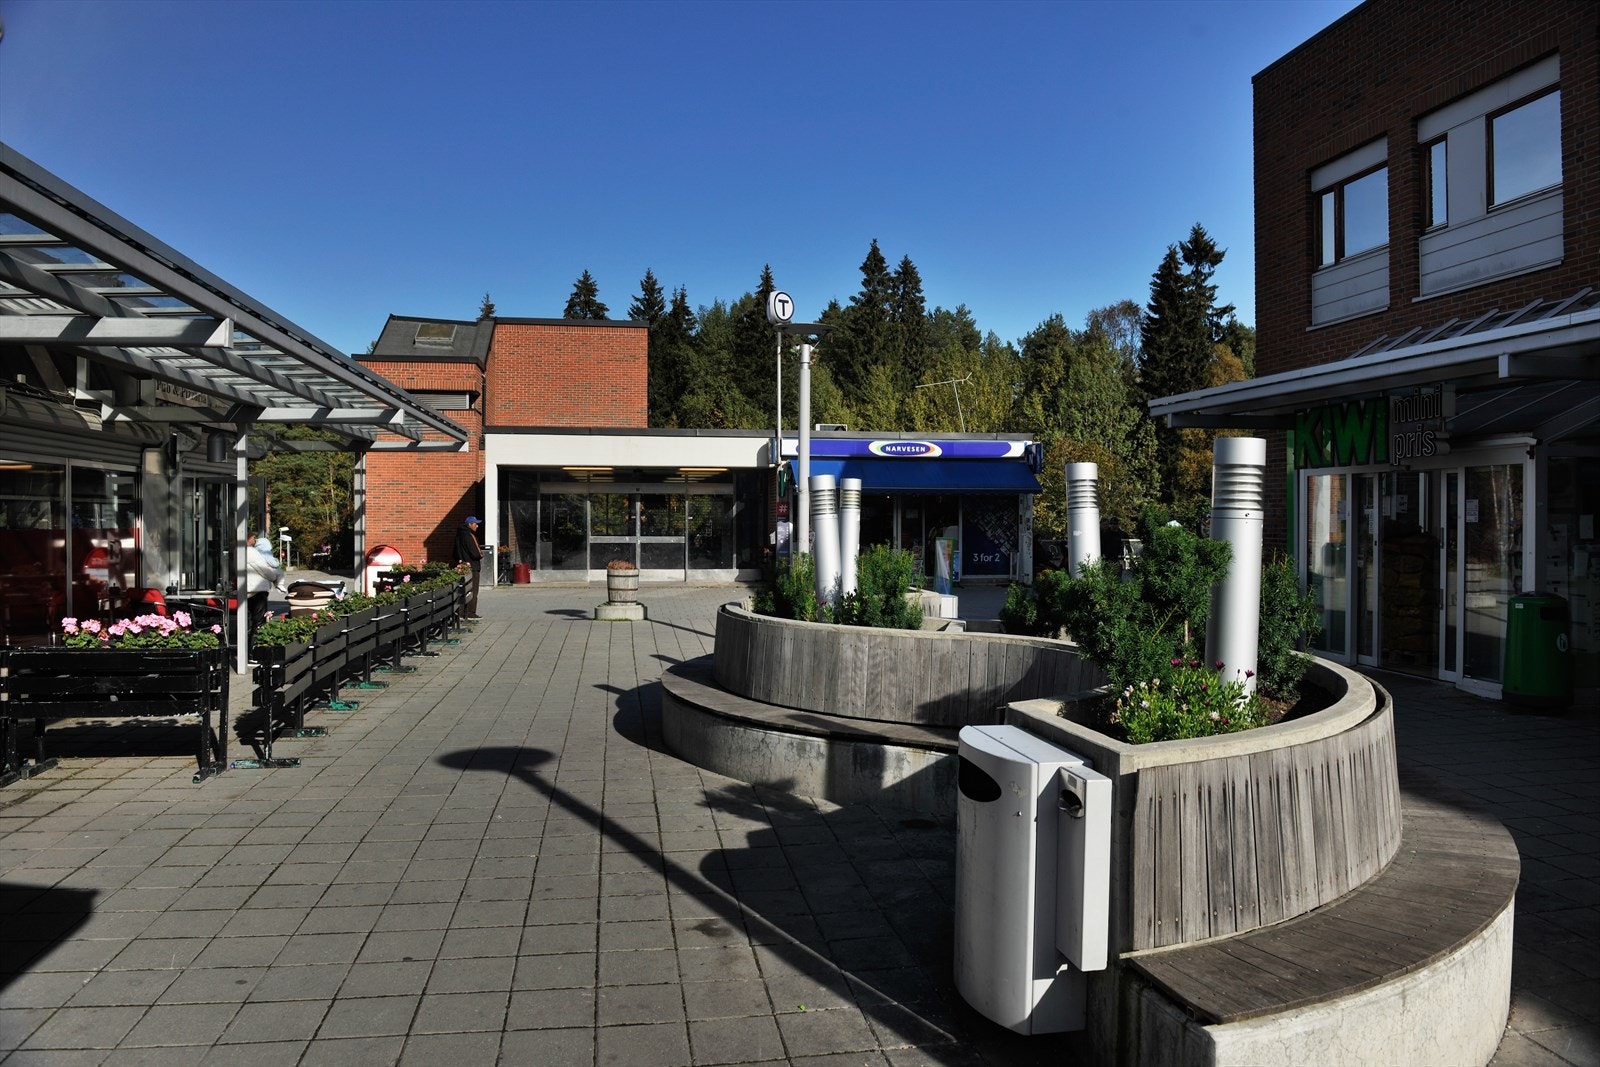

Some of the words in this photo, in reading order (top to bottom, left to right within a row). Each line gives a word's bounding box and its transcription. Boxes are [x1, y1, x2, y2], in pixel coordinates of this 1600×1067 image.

[777, 298, 790, 317] T
[1393, 383, 1443, 423] mini
[1294, 398, 1389, 468] KIWI
[1393, 424, 1437, 466] pris
[885, 445, 926, 453] NARVESEN
[972, 553, 979, 562] 3
[980, 553, 993, 562] for
[994, 553, 1000, 562] 2
